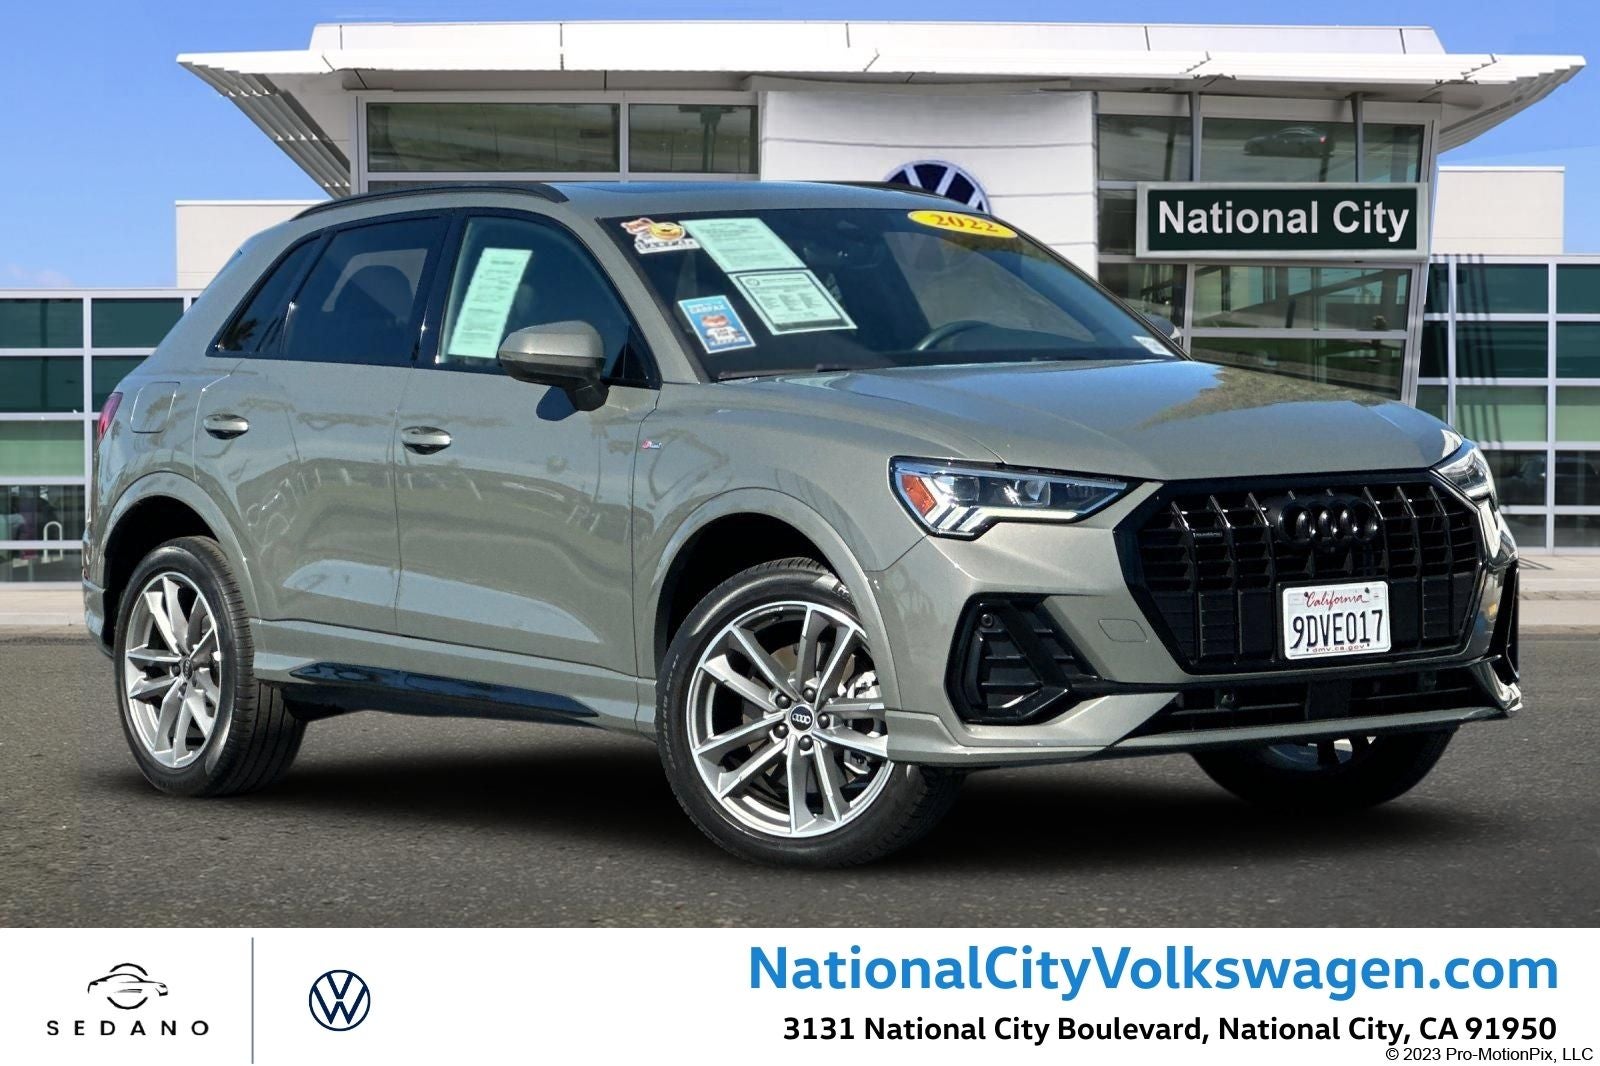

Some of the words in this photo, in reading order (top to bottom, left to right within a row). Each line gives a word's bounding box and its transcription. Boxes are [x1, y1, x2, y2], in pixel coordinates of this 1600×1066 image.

[929, 213, 999, 233] 2022
[1158, 200, 1318, 234] National
[1333, 200, 1410, 243] City
[1306, 590, 1370, 611] California
[1290, 608, 1384, 650] 9DVE017
[1311, 644, 1365, 654] dmv.ca.gov
